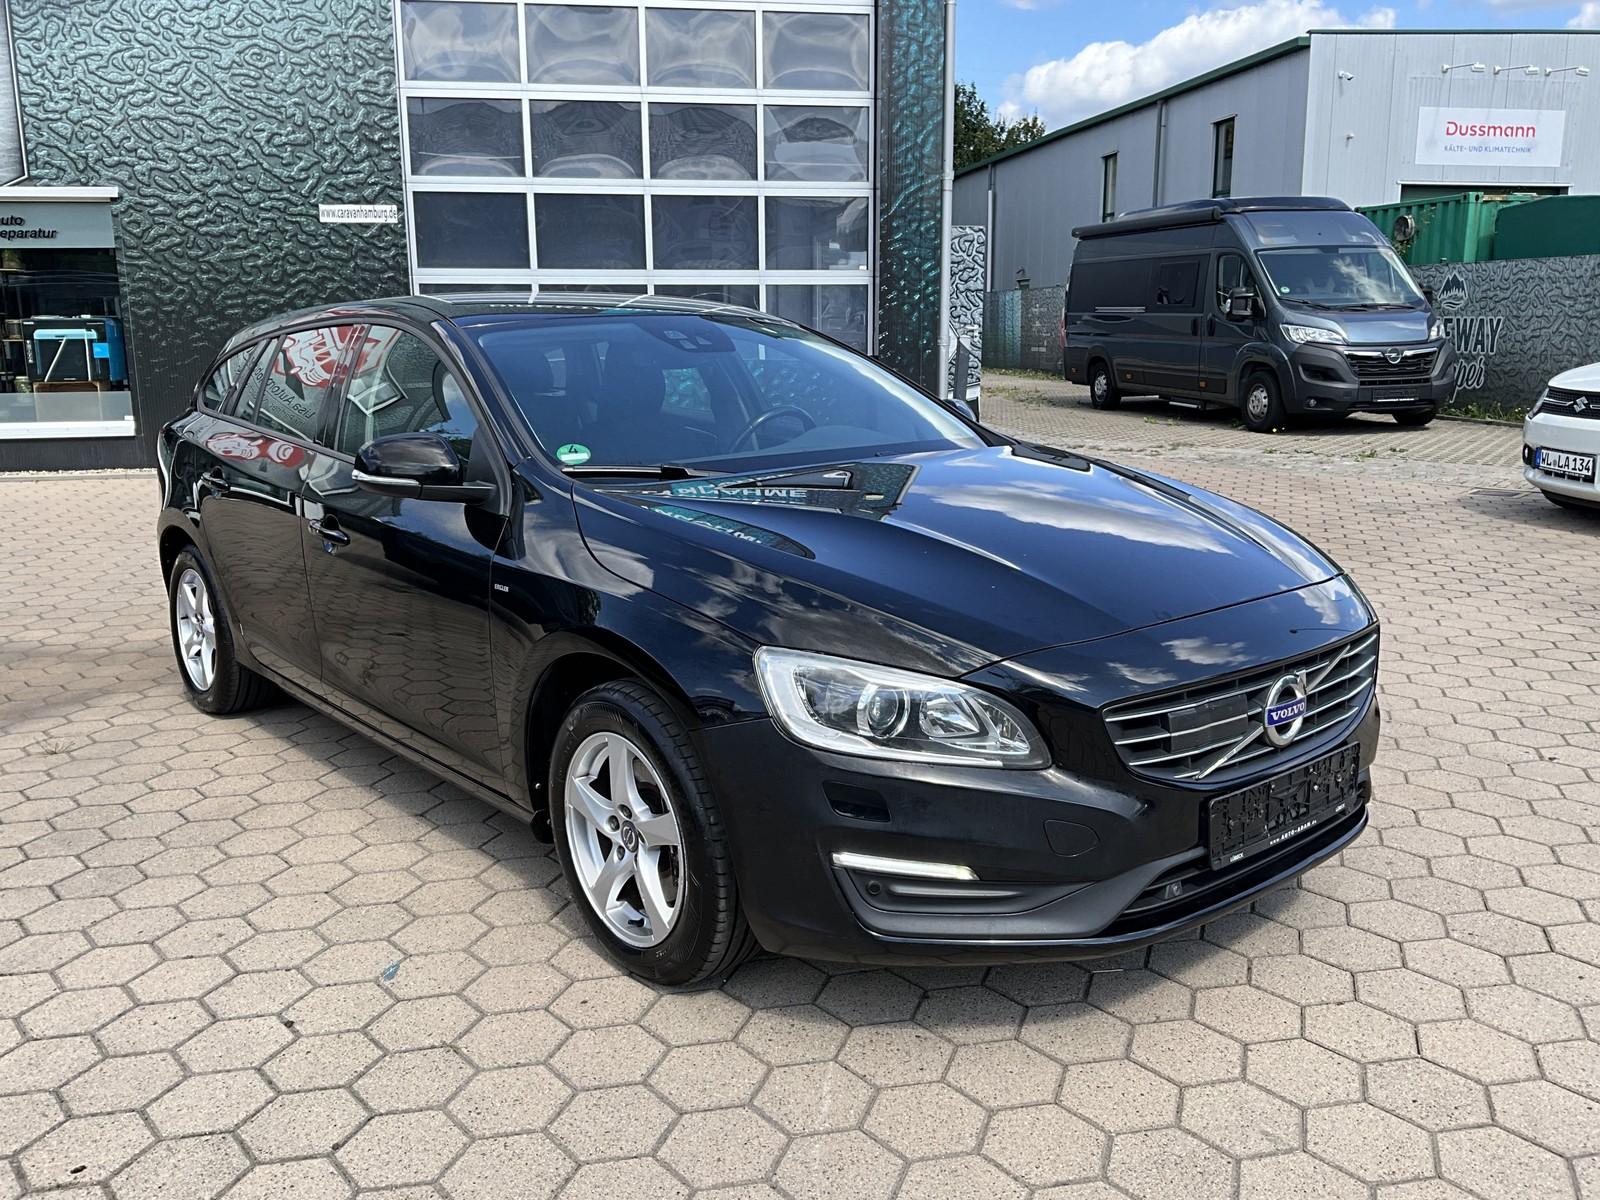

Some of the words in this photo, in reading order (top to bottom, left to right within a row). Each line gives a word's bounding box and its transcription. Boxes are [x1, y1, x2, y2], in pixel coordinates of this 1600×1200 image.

[1445, 121, 1536, 138] Dussmann
[1444, 143, 1467, 152] KÄLTE-
[0, 214, 25, 226] uto
[320, 205, 397, 222] www.caravanhamburg.de
[0, 228, 57, 241] eparatur
[1437, 316, 1503, 355] EWAY
[1540, 451, 1552, 466] WL
[1270, 702, 1305, 721] VOLVO
